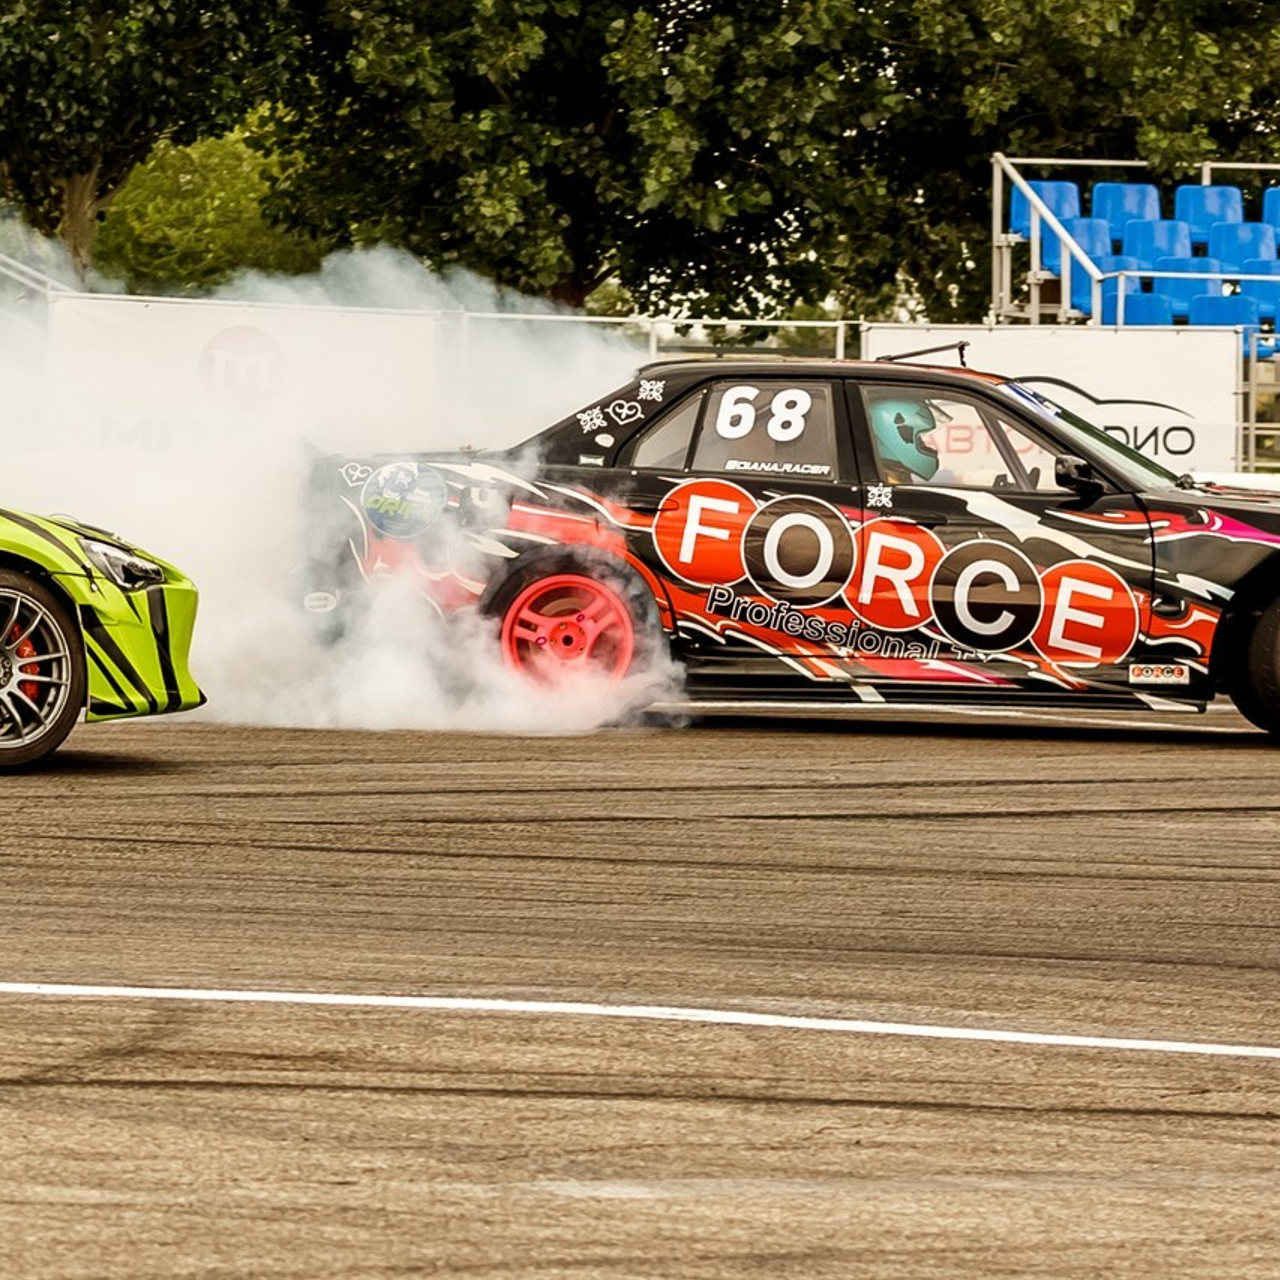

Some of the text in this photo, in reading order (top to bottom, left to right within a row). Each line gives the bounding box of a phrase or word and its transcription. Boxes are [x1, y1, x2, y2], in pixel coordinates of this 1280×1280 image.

[716, 386, 812, 441] 68
[365, 495, 432, 523] DRI
[678, 494, 1114, 659] FORCE
[704, 584, 941, 659] Professional
[1132, 666, 1185, 679] FORCE
